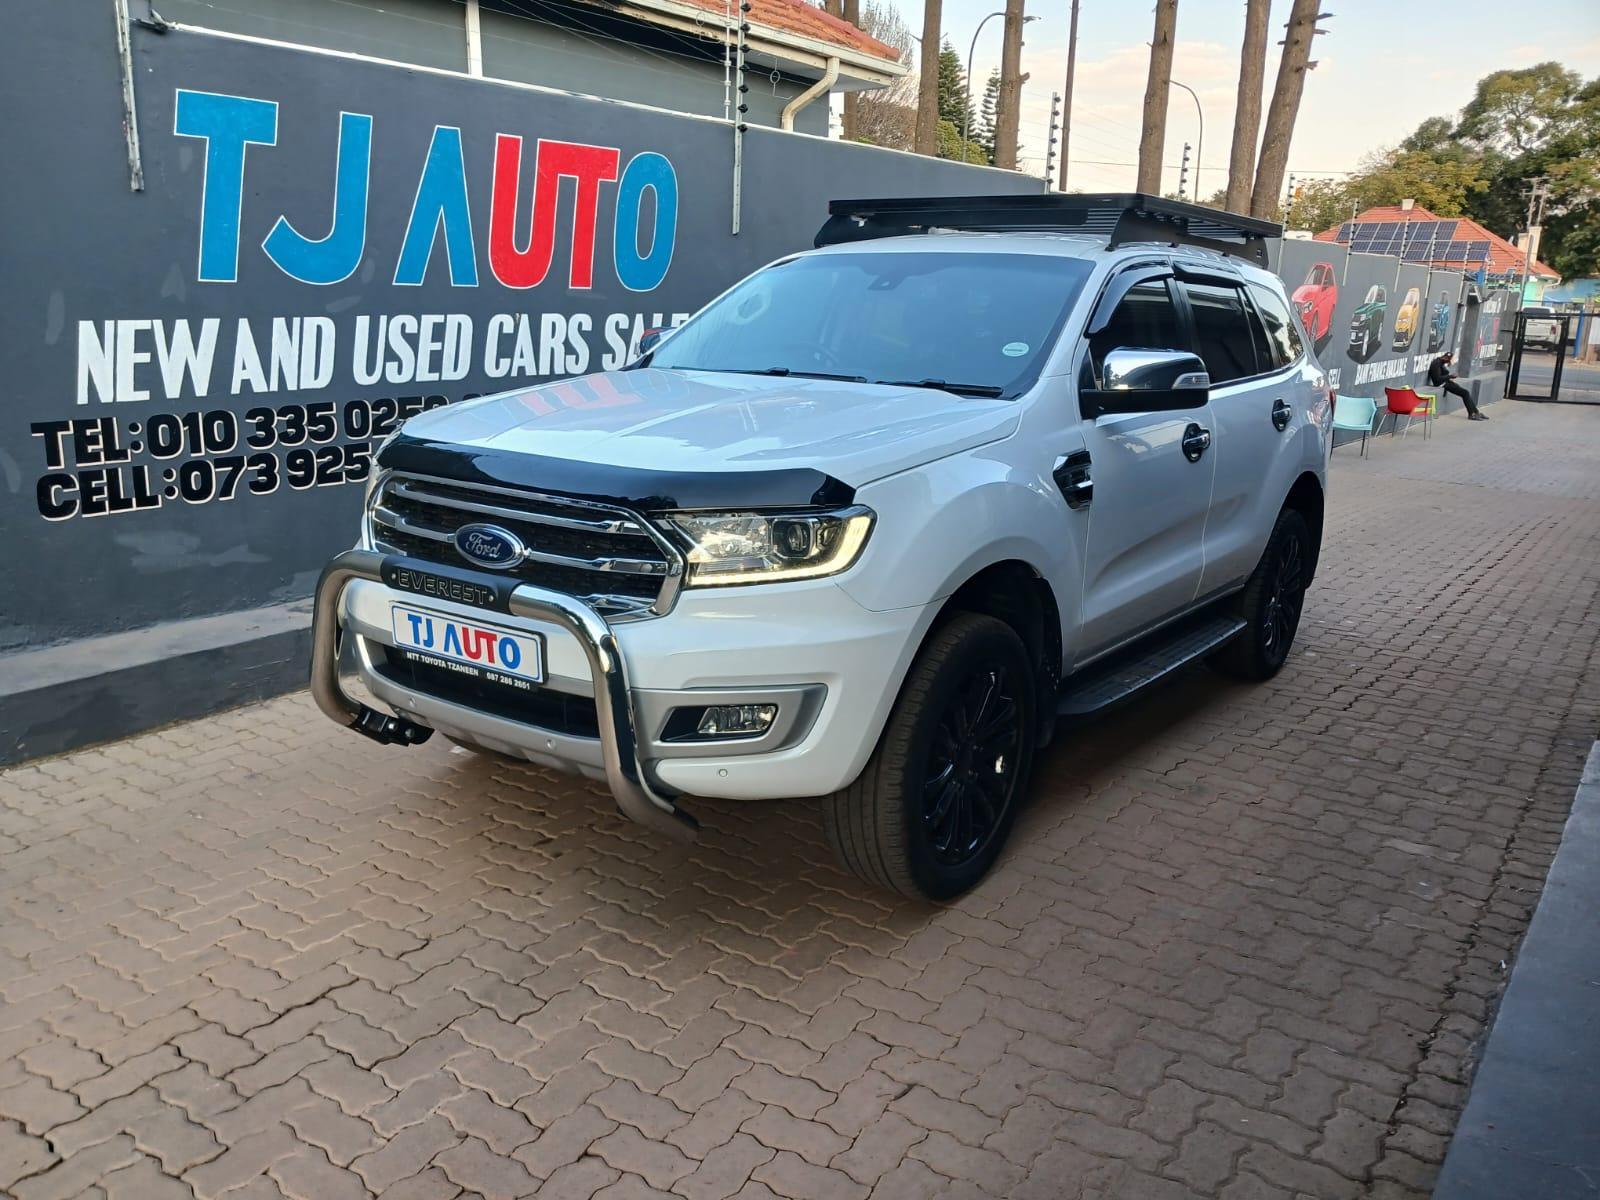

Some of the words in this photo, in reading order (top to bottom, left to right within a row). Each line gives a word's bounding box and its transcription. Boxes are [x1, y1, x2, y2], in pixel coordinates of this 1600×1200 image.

[173, 88, 373, 285] TJ
[392, 125, 679, 292] AUTO
[76, 316, 220, 405] NEW
[231, 316, 335, 395] AND
[352, 313, 472, 386] USED
[484, 313, 592, 378] CARS
[602, 313, 690, 372] SA
[245, 402, 340, 450] 335
[286, 442, 372, 491] 925
[465, 532, 501, 559] Ford
[398, 569, 489, 605] EVEREST
[408, 613, 434, 648] TJ
[444, 623, 521, 670] AUTO
[421, 655, 447, 668] TOYOTA
[447, 661, 479, 677] TZANEEN
